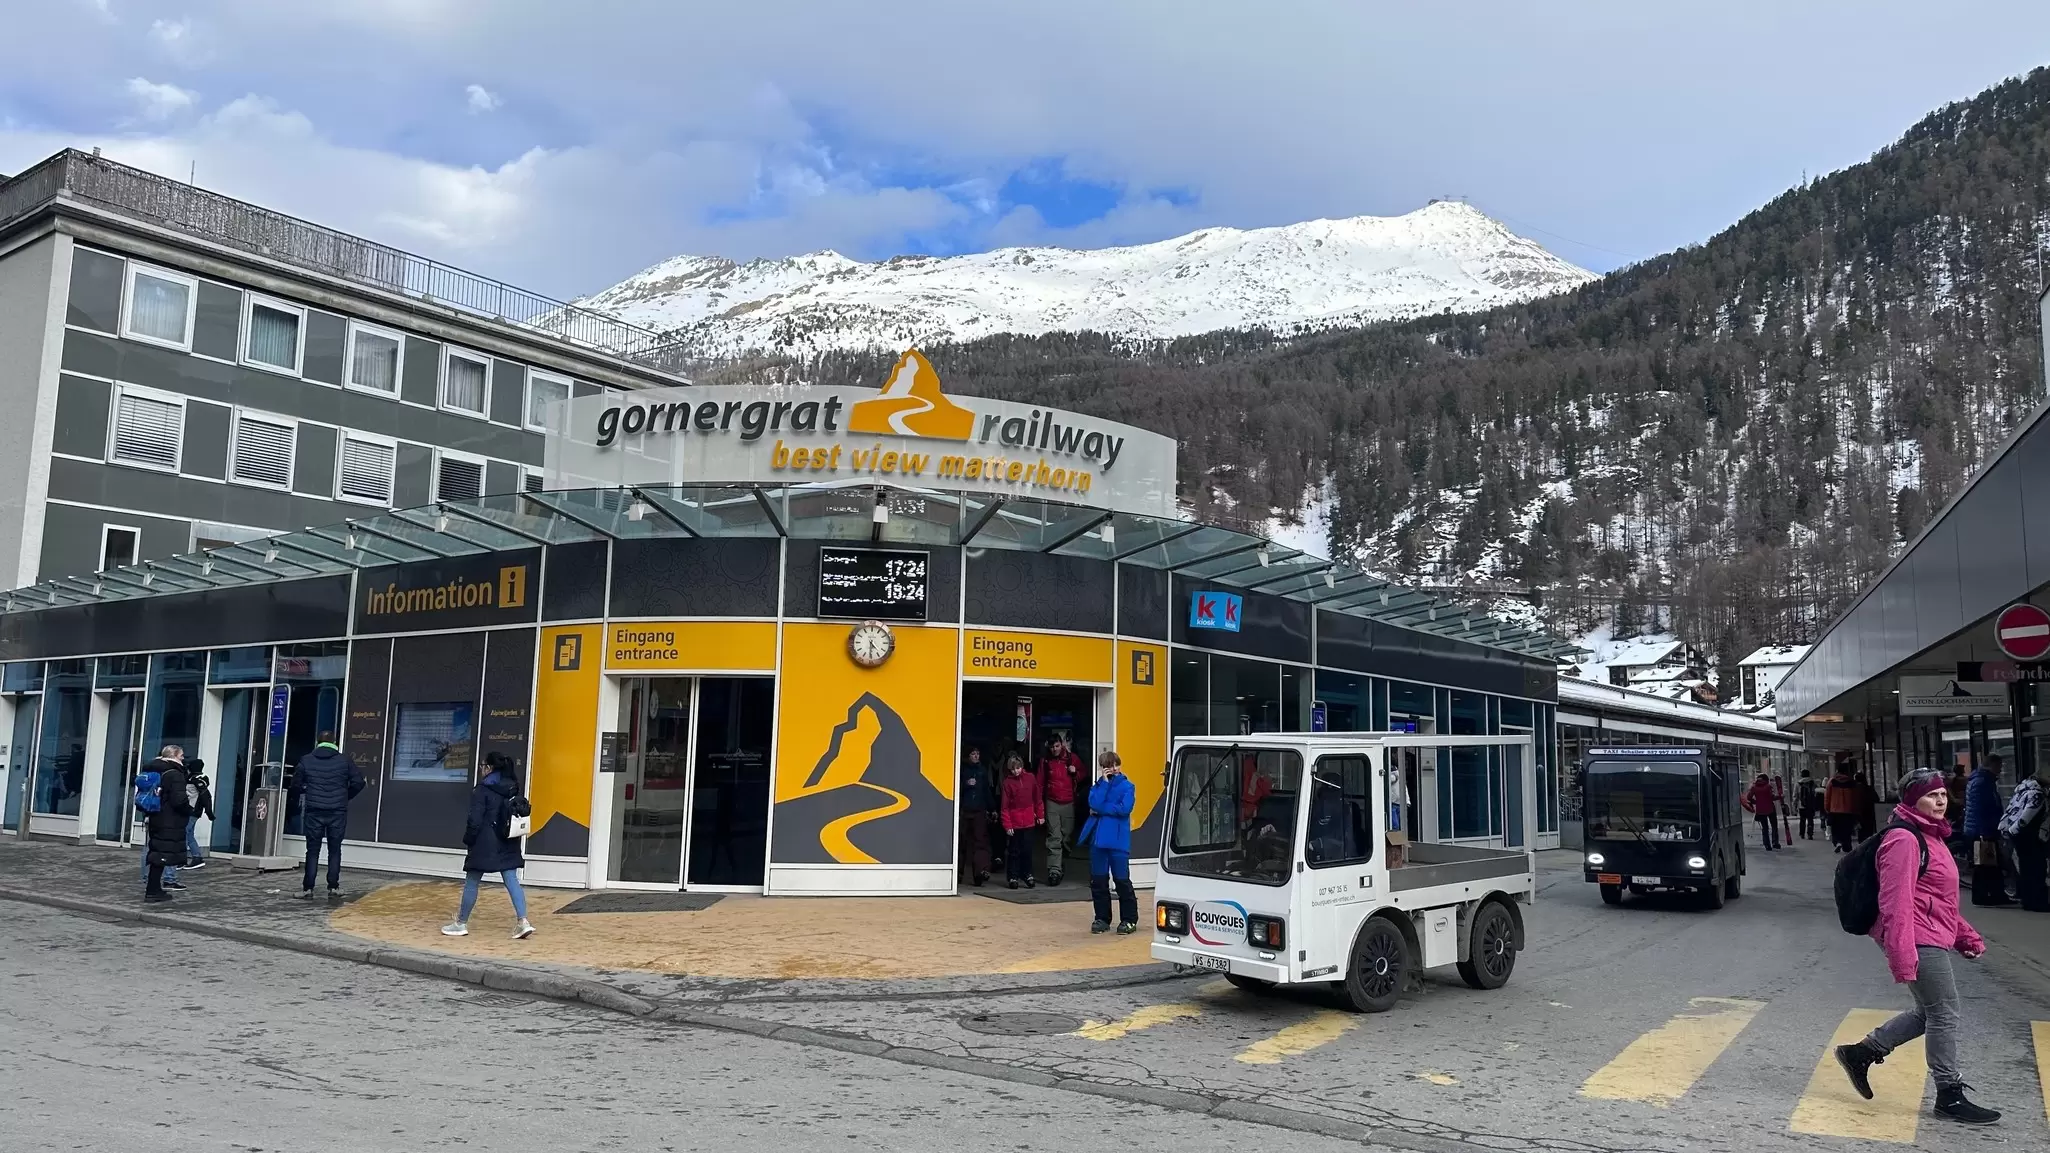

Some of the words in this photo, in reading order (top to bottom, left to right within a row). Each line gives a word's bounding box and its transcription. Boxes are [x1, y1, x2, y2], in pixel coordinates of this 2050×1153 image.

[596, 395, 843, 447] gornergrat
[980, 409, 1125, 471] railway
[771, 440, 842, 470] best
[852, 443, 930, 474] view
[938, 455, 1092, 493] matterhorn
[885, 559, 926, 578] 17:24
[366, 576, 493, 616] Information
[1197, 594, 1217, 618] k
[1196, 618, 1216, 627] kiosk
[616, 629, 675, 647] Eingang
[973, 636, 1034, 656] Eingang
[615, 647, 679, 660] entrance
[972, 656, 1037, 670] entrance
[1195, 911, 1245, 929] BOUYGUES
